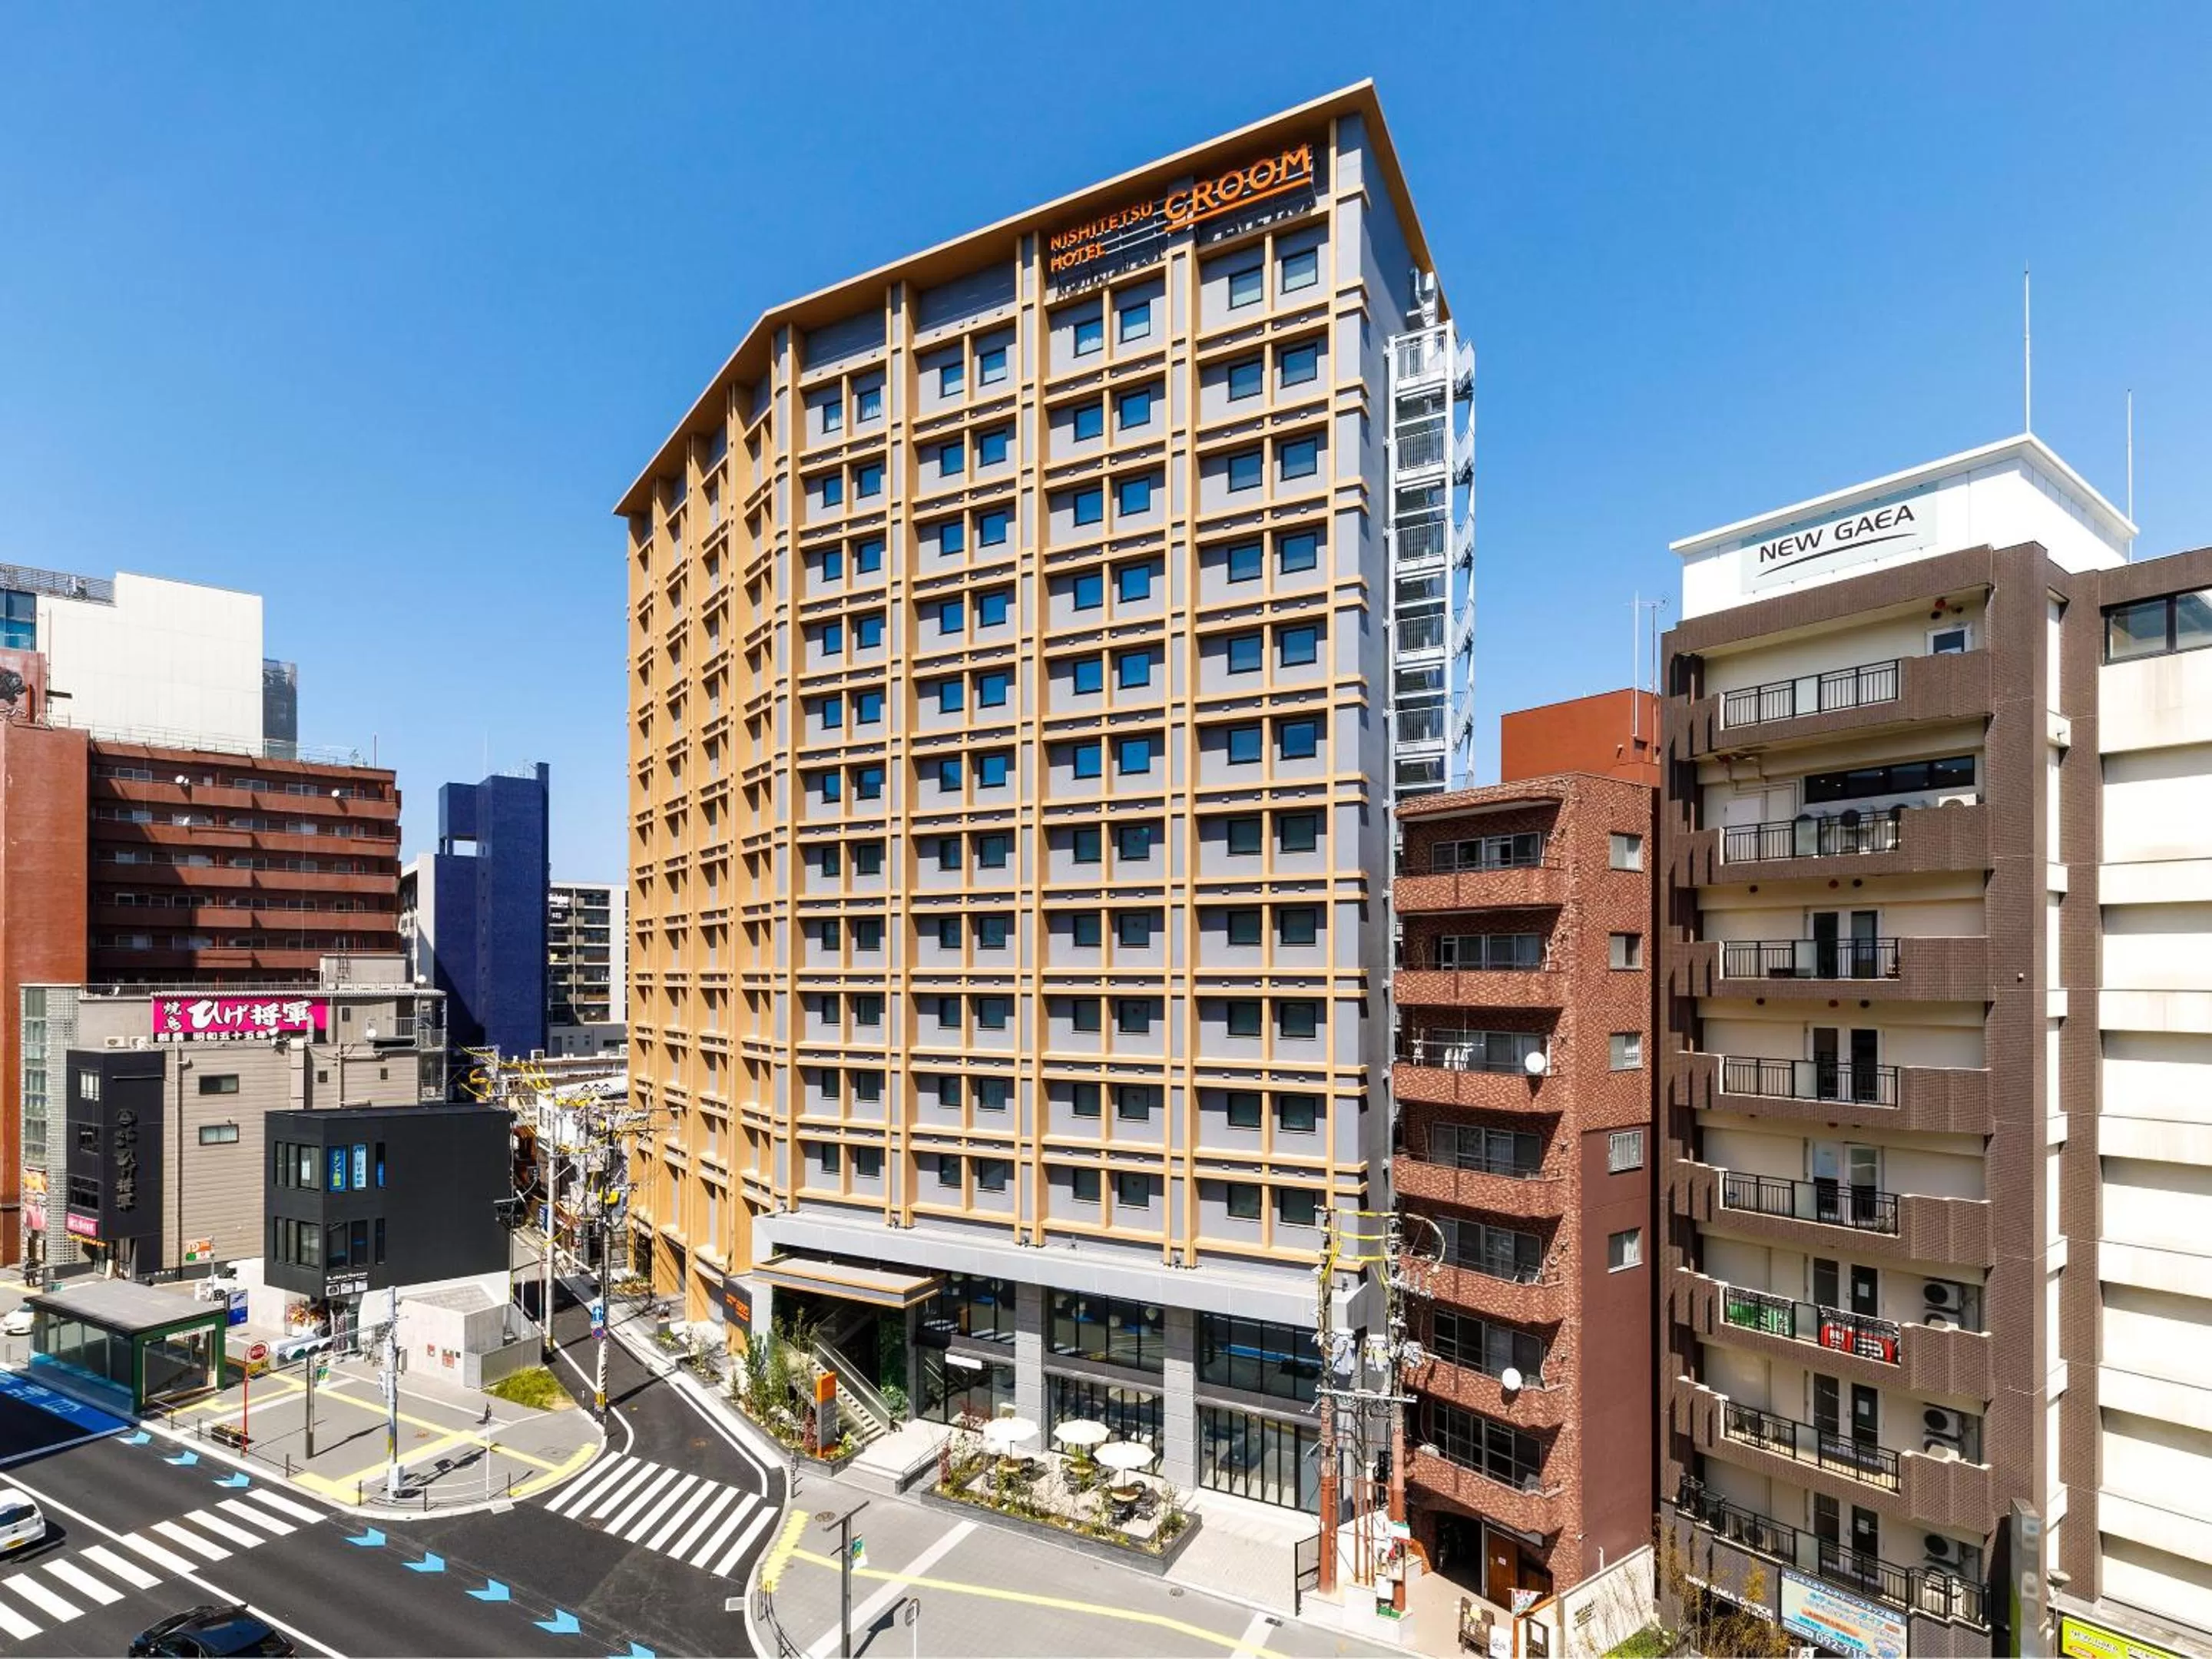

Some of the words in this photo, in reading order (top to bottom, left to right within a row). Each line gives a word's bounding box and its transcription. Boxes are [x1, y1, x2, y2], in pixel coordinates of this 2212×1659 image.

[1051, 200, 1154, 250] NISHITETSU
[1164, 141, 1313, 221] CROOM
[1050, 242, 1106, 272] HOTEL
[1759, 528, 1823, 563] NEW
[1833, 505, 1916, 541] GAEA
[187, 998, 313, 1029] ひげ将軍
